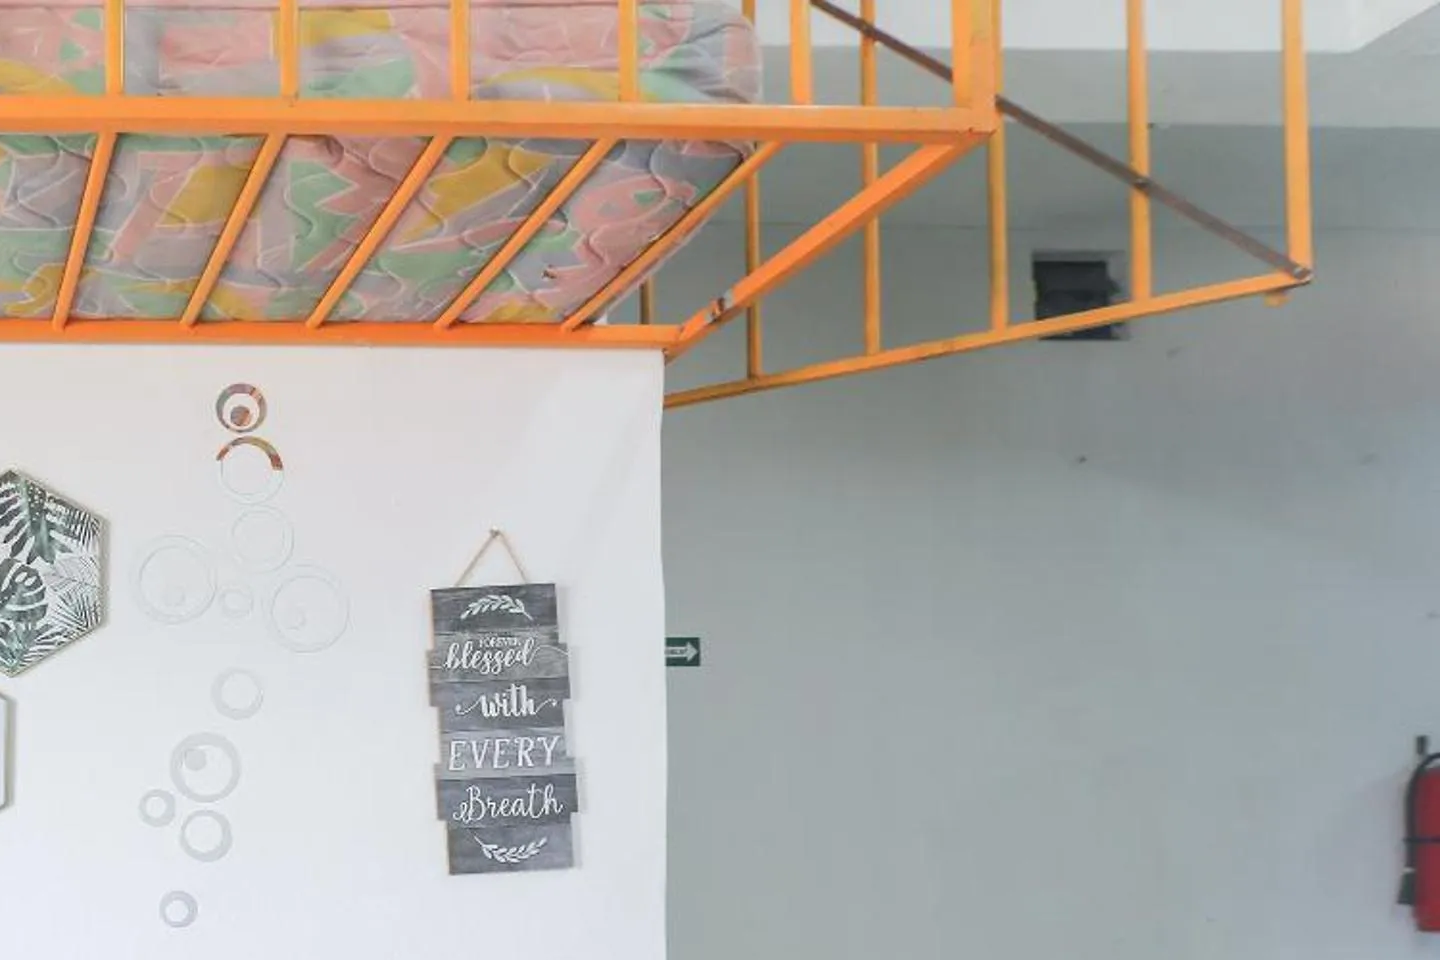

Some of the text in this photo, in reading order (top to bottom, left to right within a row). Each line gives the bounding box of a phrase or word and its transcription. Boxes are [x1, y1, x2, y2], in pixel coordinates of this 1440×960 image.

[443, 636, 537, 675] blessed
[478, 683, 537, 718] with
[448, 735, 561, 771] EVERY
[452, 783, 564, 823] Breath
